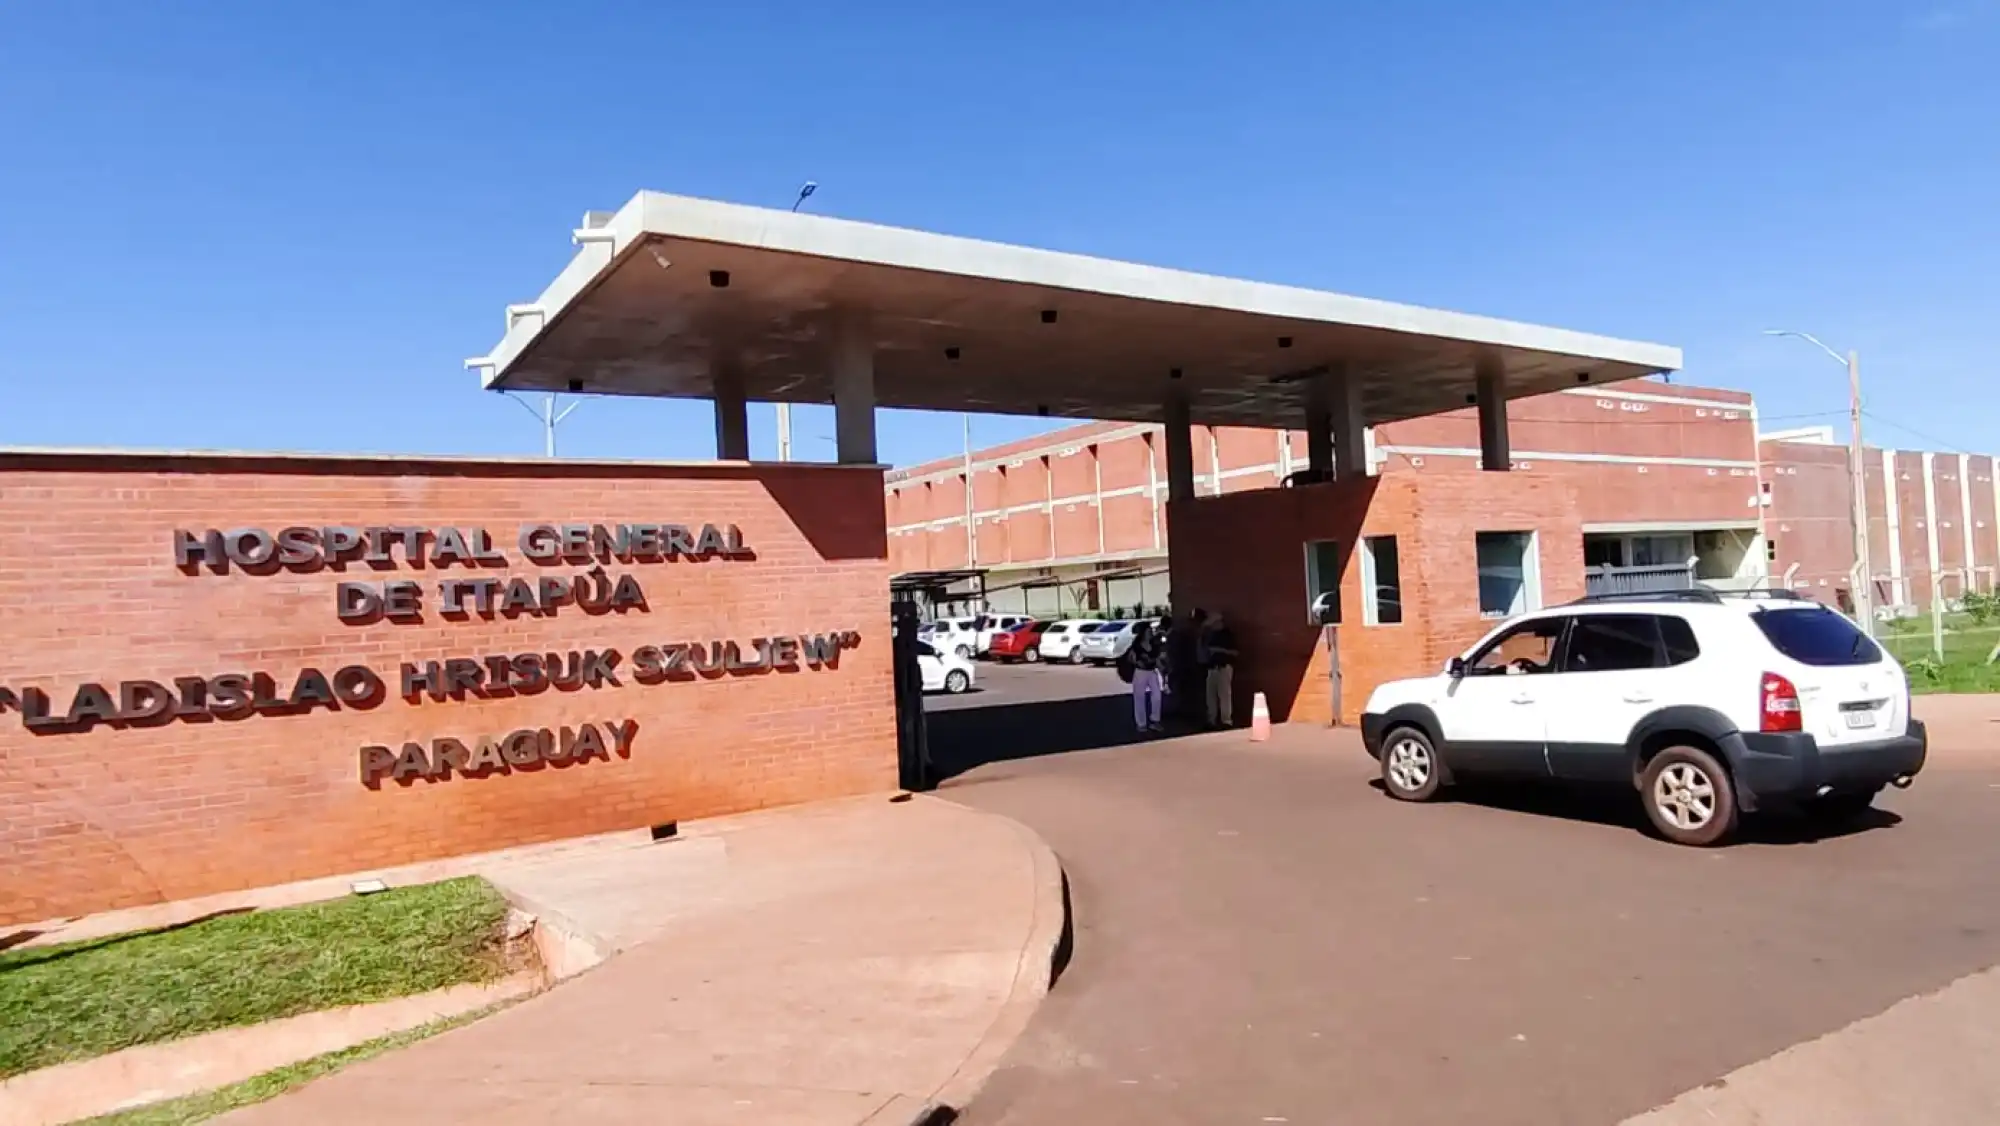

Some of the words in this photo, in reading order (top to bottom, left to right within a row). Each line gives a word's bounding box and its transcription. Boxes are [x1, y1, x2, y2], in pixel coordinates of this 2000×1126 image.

[174, 527, 507, 575] HOSPITAL
[519, 523, 755, 565] GENERAL
[336, 579, 423, 625] DE
[439, 565, 649, 621] ITAPÚA
[402, 648, 623, 705] HRISUK
[360, 718, 639, 791] PARAGUAY
